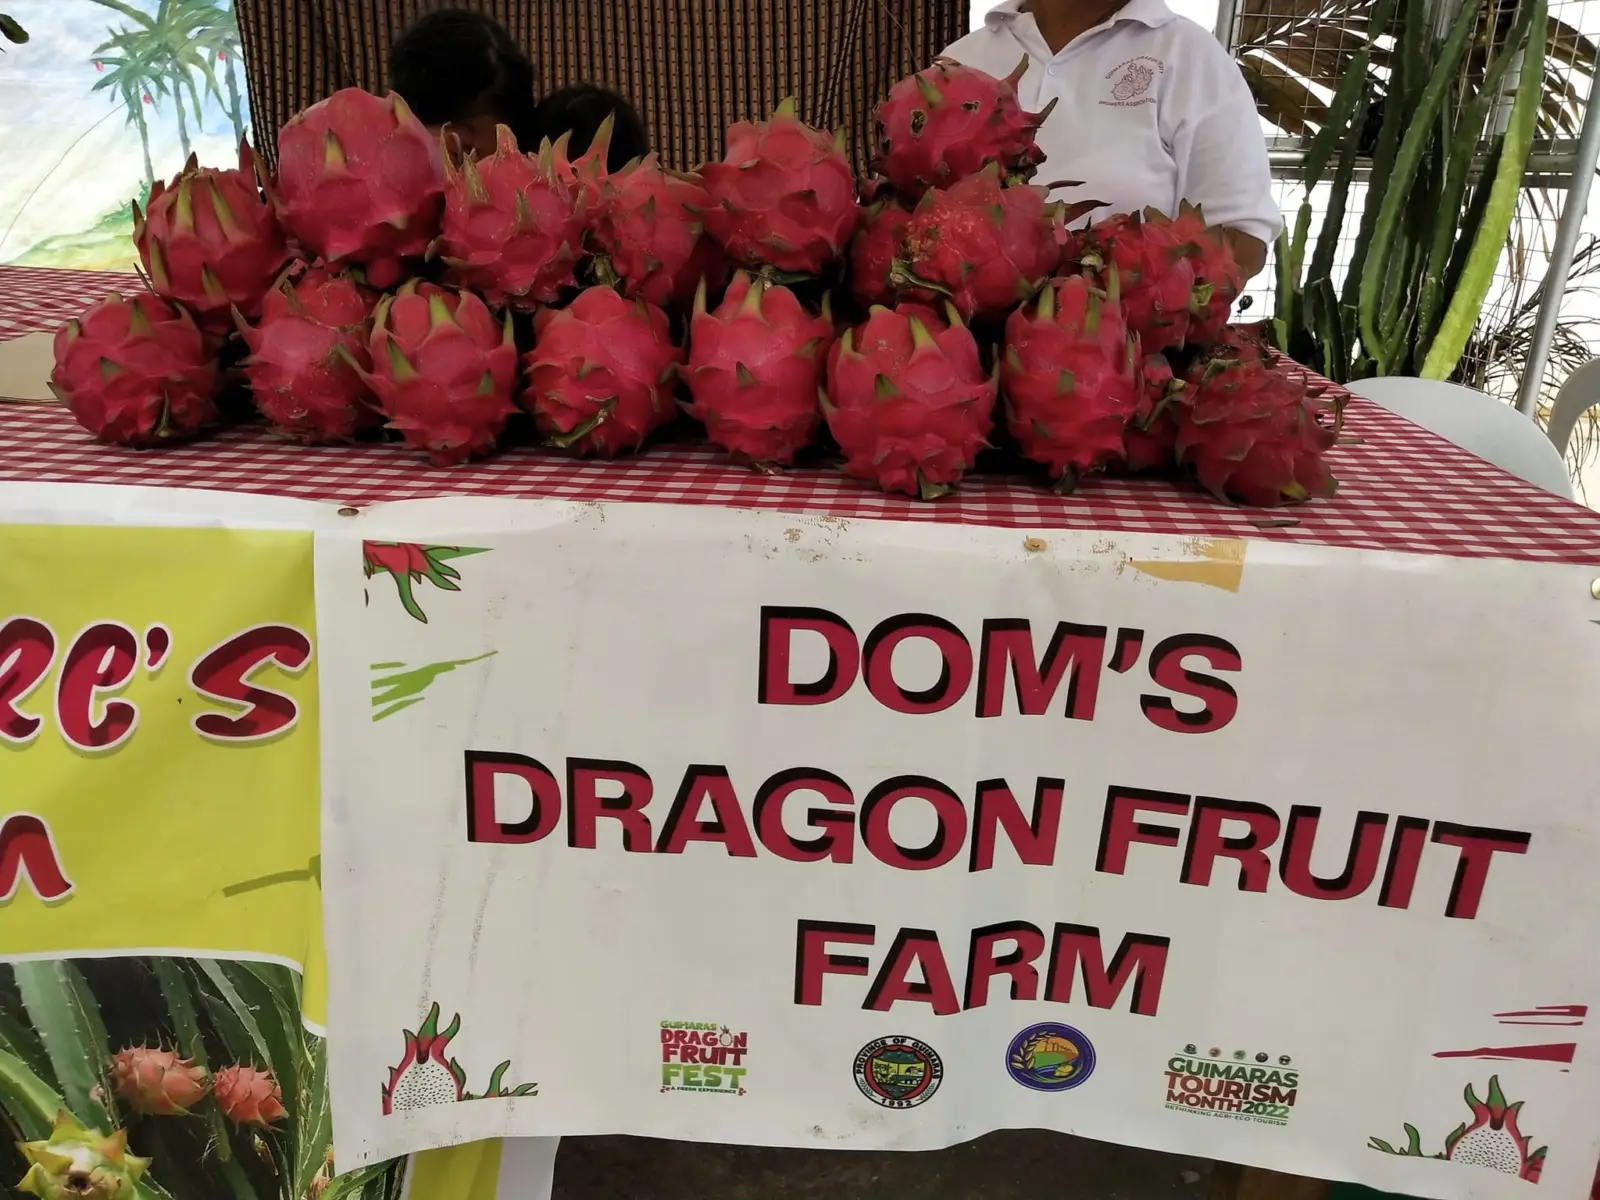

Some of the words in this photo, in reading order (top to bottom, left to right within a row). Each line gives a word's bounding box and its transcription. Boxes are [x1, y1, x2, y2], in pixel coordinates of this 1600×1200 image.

[758, 605, 1242, 734] DOM'S
[464, 750, 1065, 873] DRAGON
[1095, 785, 1532, 920] FRUIT
[794, 919, 1171, 1017] FARM
[660, 1020, 717, 1031] GUIMARAS
[660, 1026, 748, 1047] DRAGON
[662, 1044, 748, 1066] FRUIT
[856, 1039, 888, 1075] PROVINCE
[911, 1042, 941, 1080] GUIMARAS
[662, 1063, 747, 1089] FEST
[1167, 1057, 1299, 1088] GUIMARAS
[881, 1098, 913, 1107] 1992
[1164, 1070, 1298, 1107] TOURISM
[1164, 1103, 1212, 1117] RETHINKING
[1213, 1111, 1251, 1122] AGRI-ECO
[1253, 1117, 1288, 1127] TOURISM
[1166, 1090, 1243, 1112] MONTH
[1241, 1100, 1290, 1119] 2022
